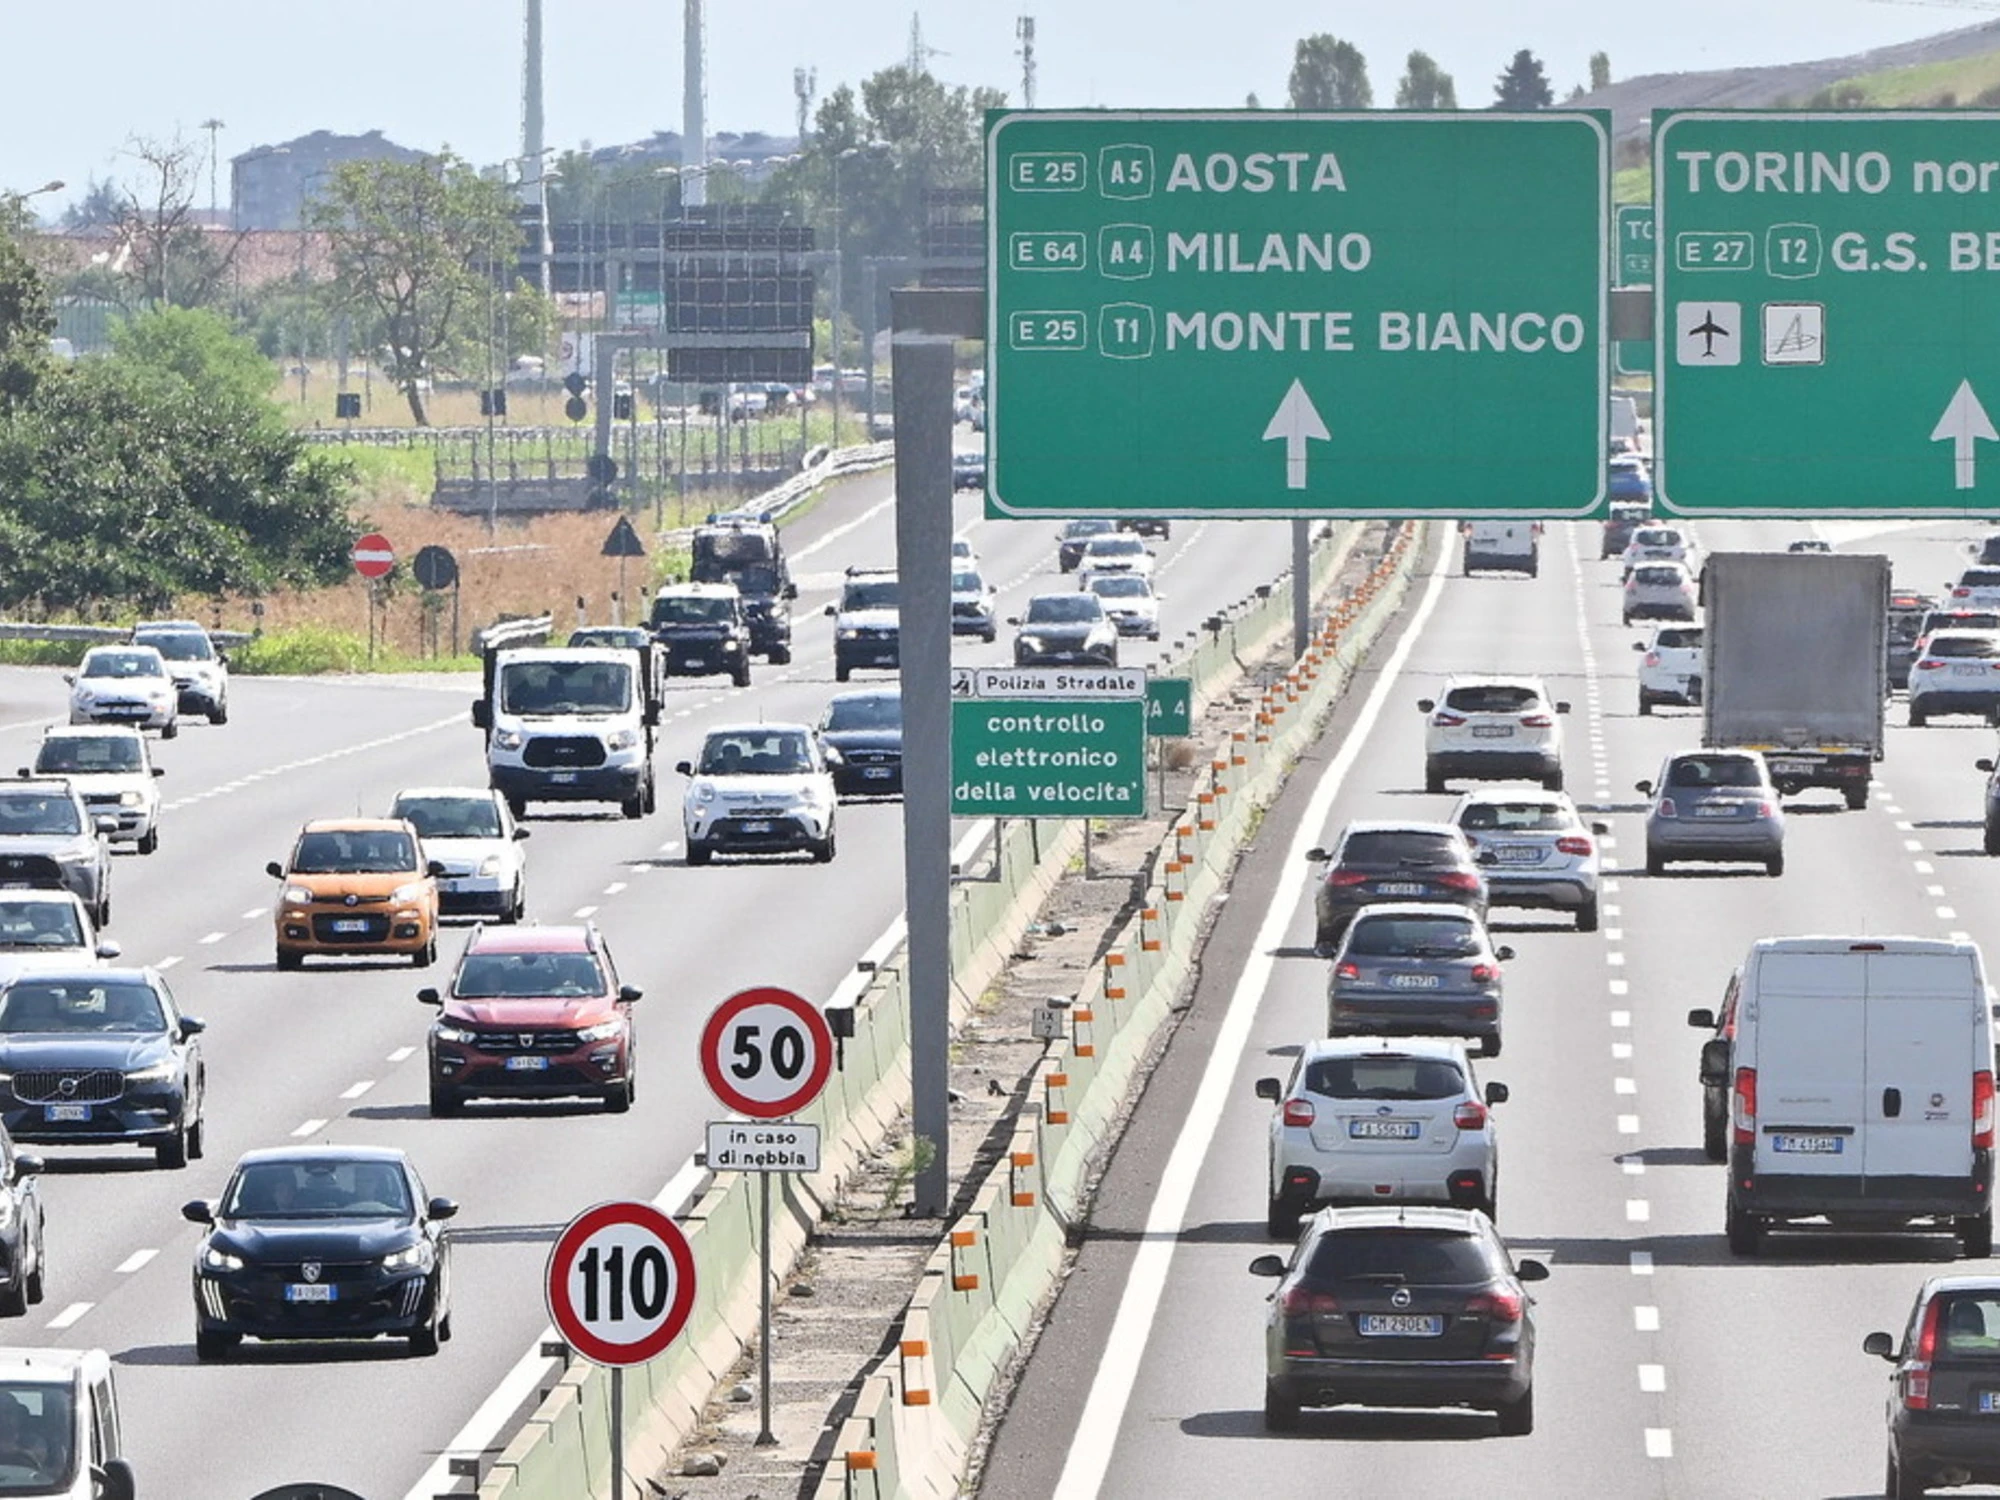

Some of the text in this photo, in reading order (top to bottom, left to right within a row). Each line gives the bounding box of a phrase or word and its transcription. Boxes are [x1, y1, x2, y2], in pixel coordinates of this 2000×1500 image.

[1019, 162, 1077, 183] E 25
[1110, 159, 1143, 184] A5
[1166, 152, 1347, 193] AOSTA
[1677, 151, 2000, 194] TORINO nor
[1018, 241, 1078, 262] E 64
[1110, 239, 1144, 264] A4
[1168, 231, 1372, 273] MILANO
[1685, 241, 1745, 262] E 27
[1779, 238, 1808, 264] T2
[1831, 231, 1928, 272] G.S.
[1019, 320, 1077, 341] E 25
[1114, 318, 1139, 343] T1
[1167, 311, 1585, 353] MONTE BIANCO
[986, 675, 1136, 691] Polizia Stradale
[987, 713, 1105, 734] controllo
[975, 746, 1118, 767] elettronico
[954, 781, 1016, 801] della
[731, 1025, 806, 1081] 50
[729, 1129, 797, 1145] in caso
[718, 1149, 807, 1167] di nebbia
[578, 1244, 669, 1322] 110
